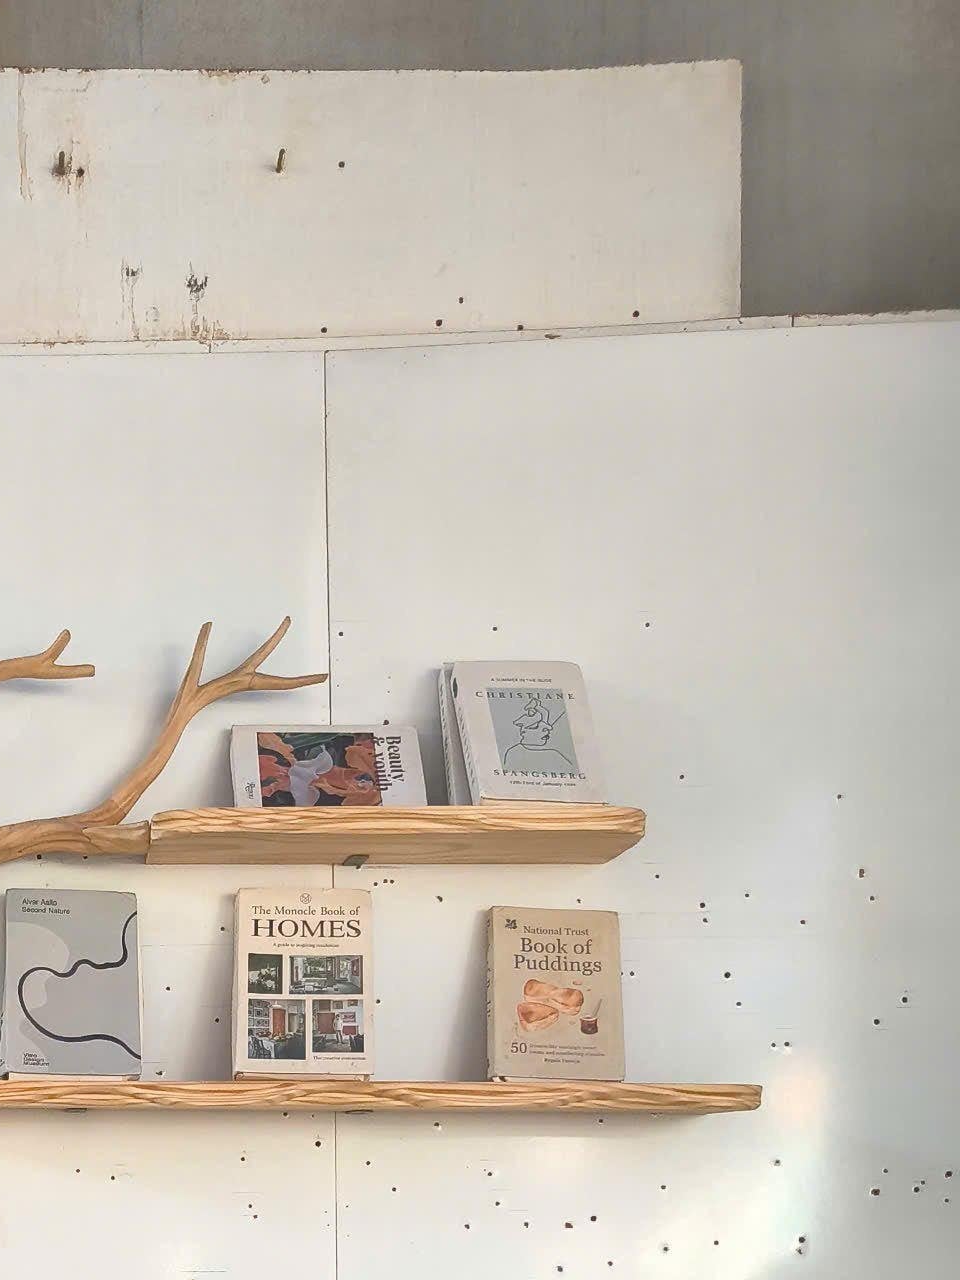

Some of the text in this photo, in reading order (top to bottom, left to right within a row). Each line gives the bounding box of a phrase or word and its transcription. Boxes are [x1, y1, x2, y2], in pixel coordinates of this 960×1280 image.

[476, 691, 575, 700] CHRISTIANE
[386, 736, 405, 782] Beauty
[372, 752, 392, 791] youth
[493, 769, 586, 780] SPANGSBERG
[252, 906, 361, 916] The Monocle Book of
[251, 919, 362, 938] HOMES
[523, 926, 589, 936] National Trust
[520, 937, 593, 955] Book of
[514, 954, 602, 976] Puddings
[510, 1042, 528, 1054] 50
